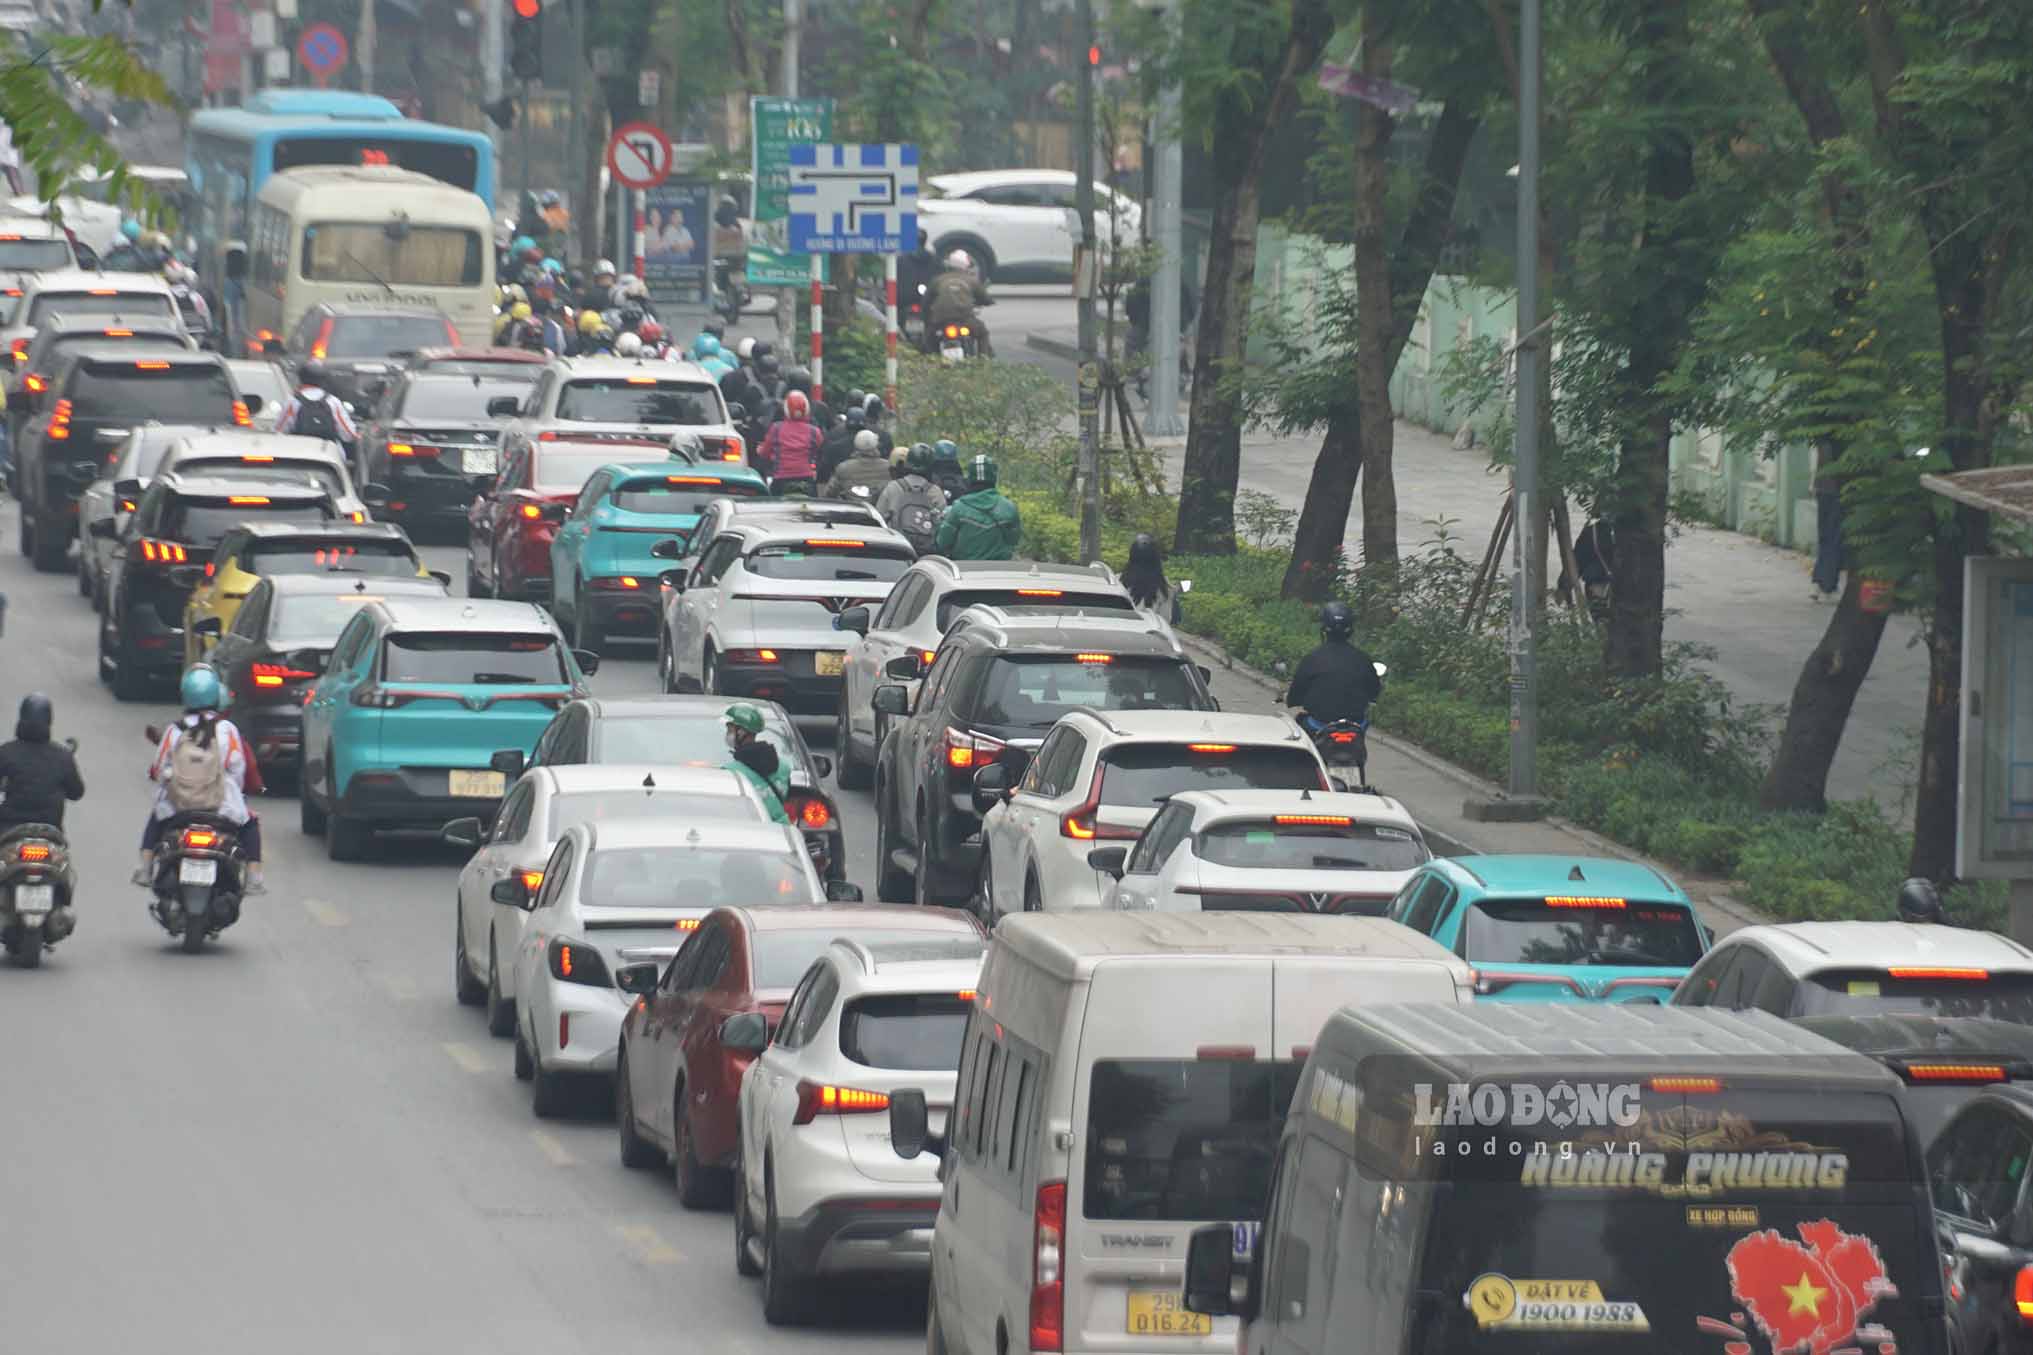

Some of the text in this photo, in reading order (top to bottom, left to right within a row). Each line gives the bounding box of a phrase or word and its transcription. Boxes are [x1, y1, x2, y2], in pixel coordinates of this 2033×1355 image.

[1685, 1150, 1849, 1188] PHƯƠNG
[1136, 1313, 1201, 1331] 016.24
[1519, 1303, 1636, 1322] 1900 1988
